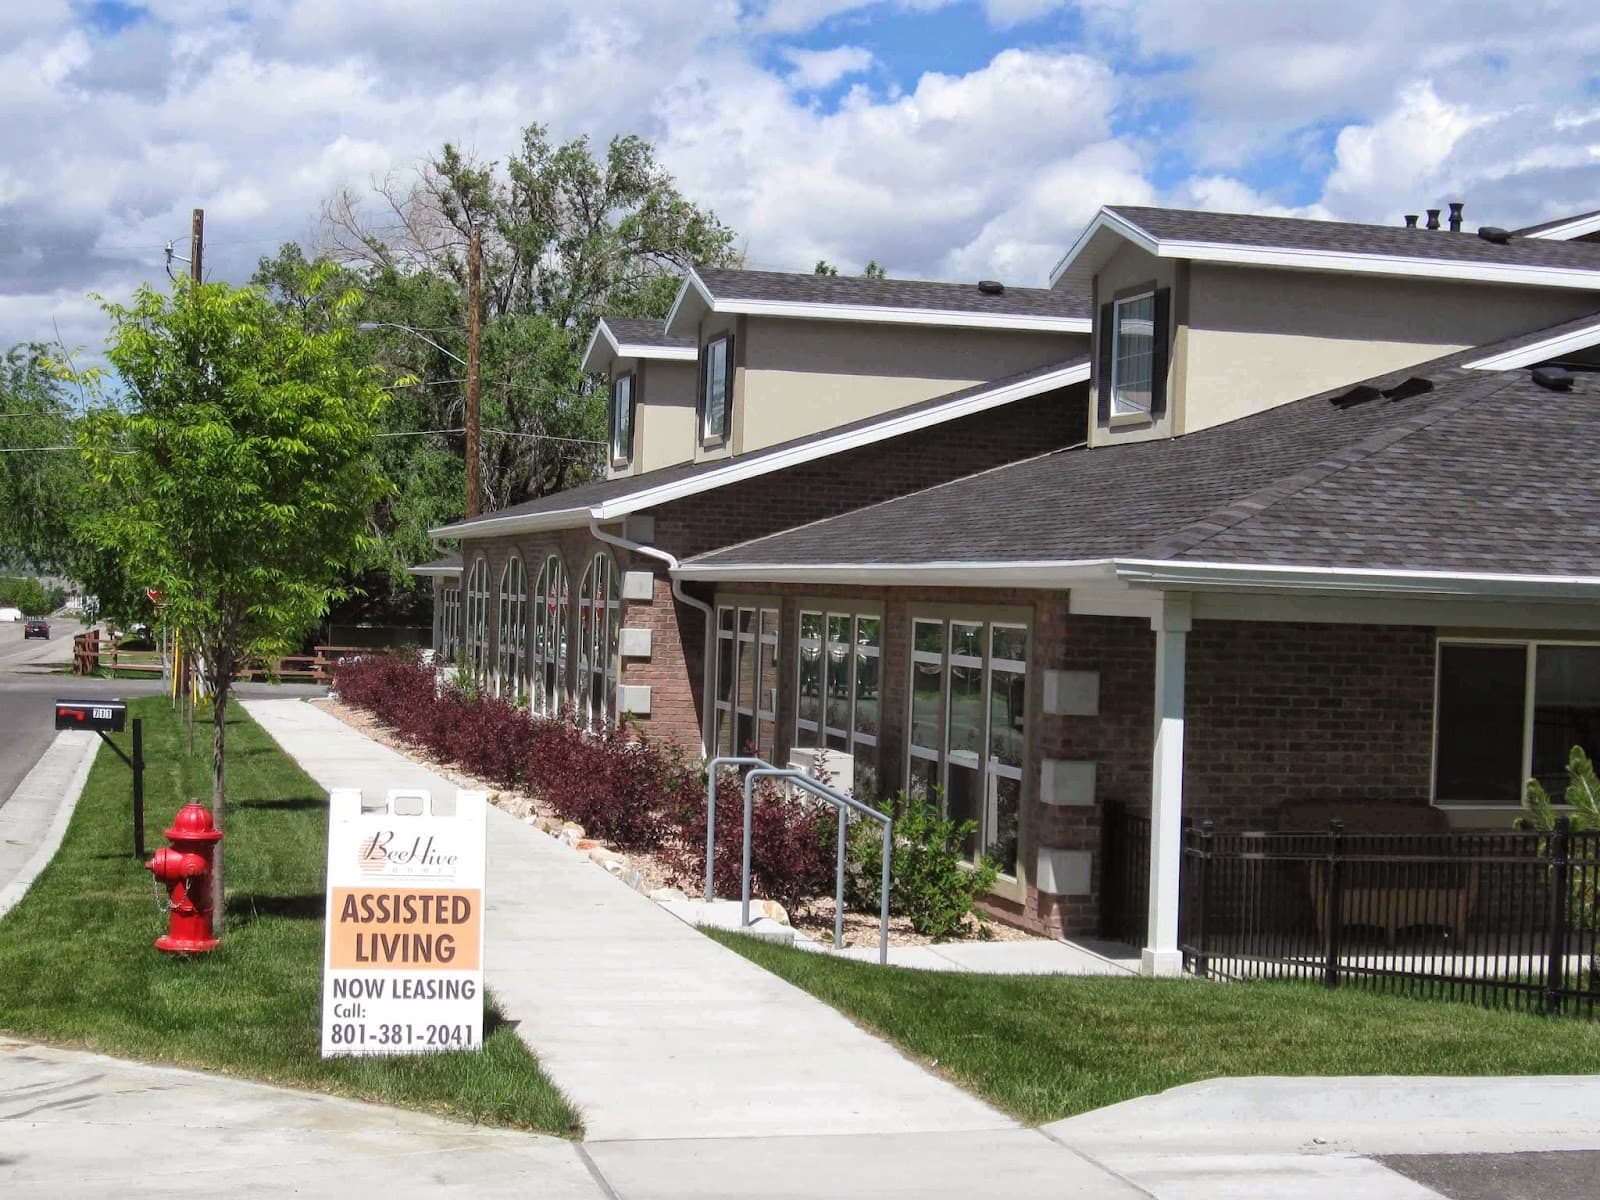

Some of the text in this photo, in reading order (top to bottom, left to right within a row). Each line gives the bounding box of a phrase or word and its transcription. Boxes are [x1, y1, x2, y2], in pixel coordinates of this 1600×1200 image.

[363, 831, 458, 865] BeeHive
[340, 894, 471, 925] ASSISTED
[356, 933, 456, 963] LIVING
[333, 978, 476, 1000] NOW LEASING
[334, 1003, 366, 1018] Call:
[331, 1024, 472, 1045] 801-381-2041
